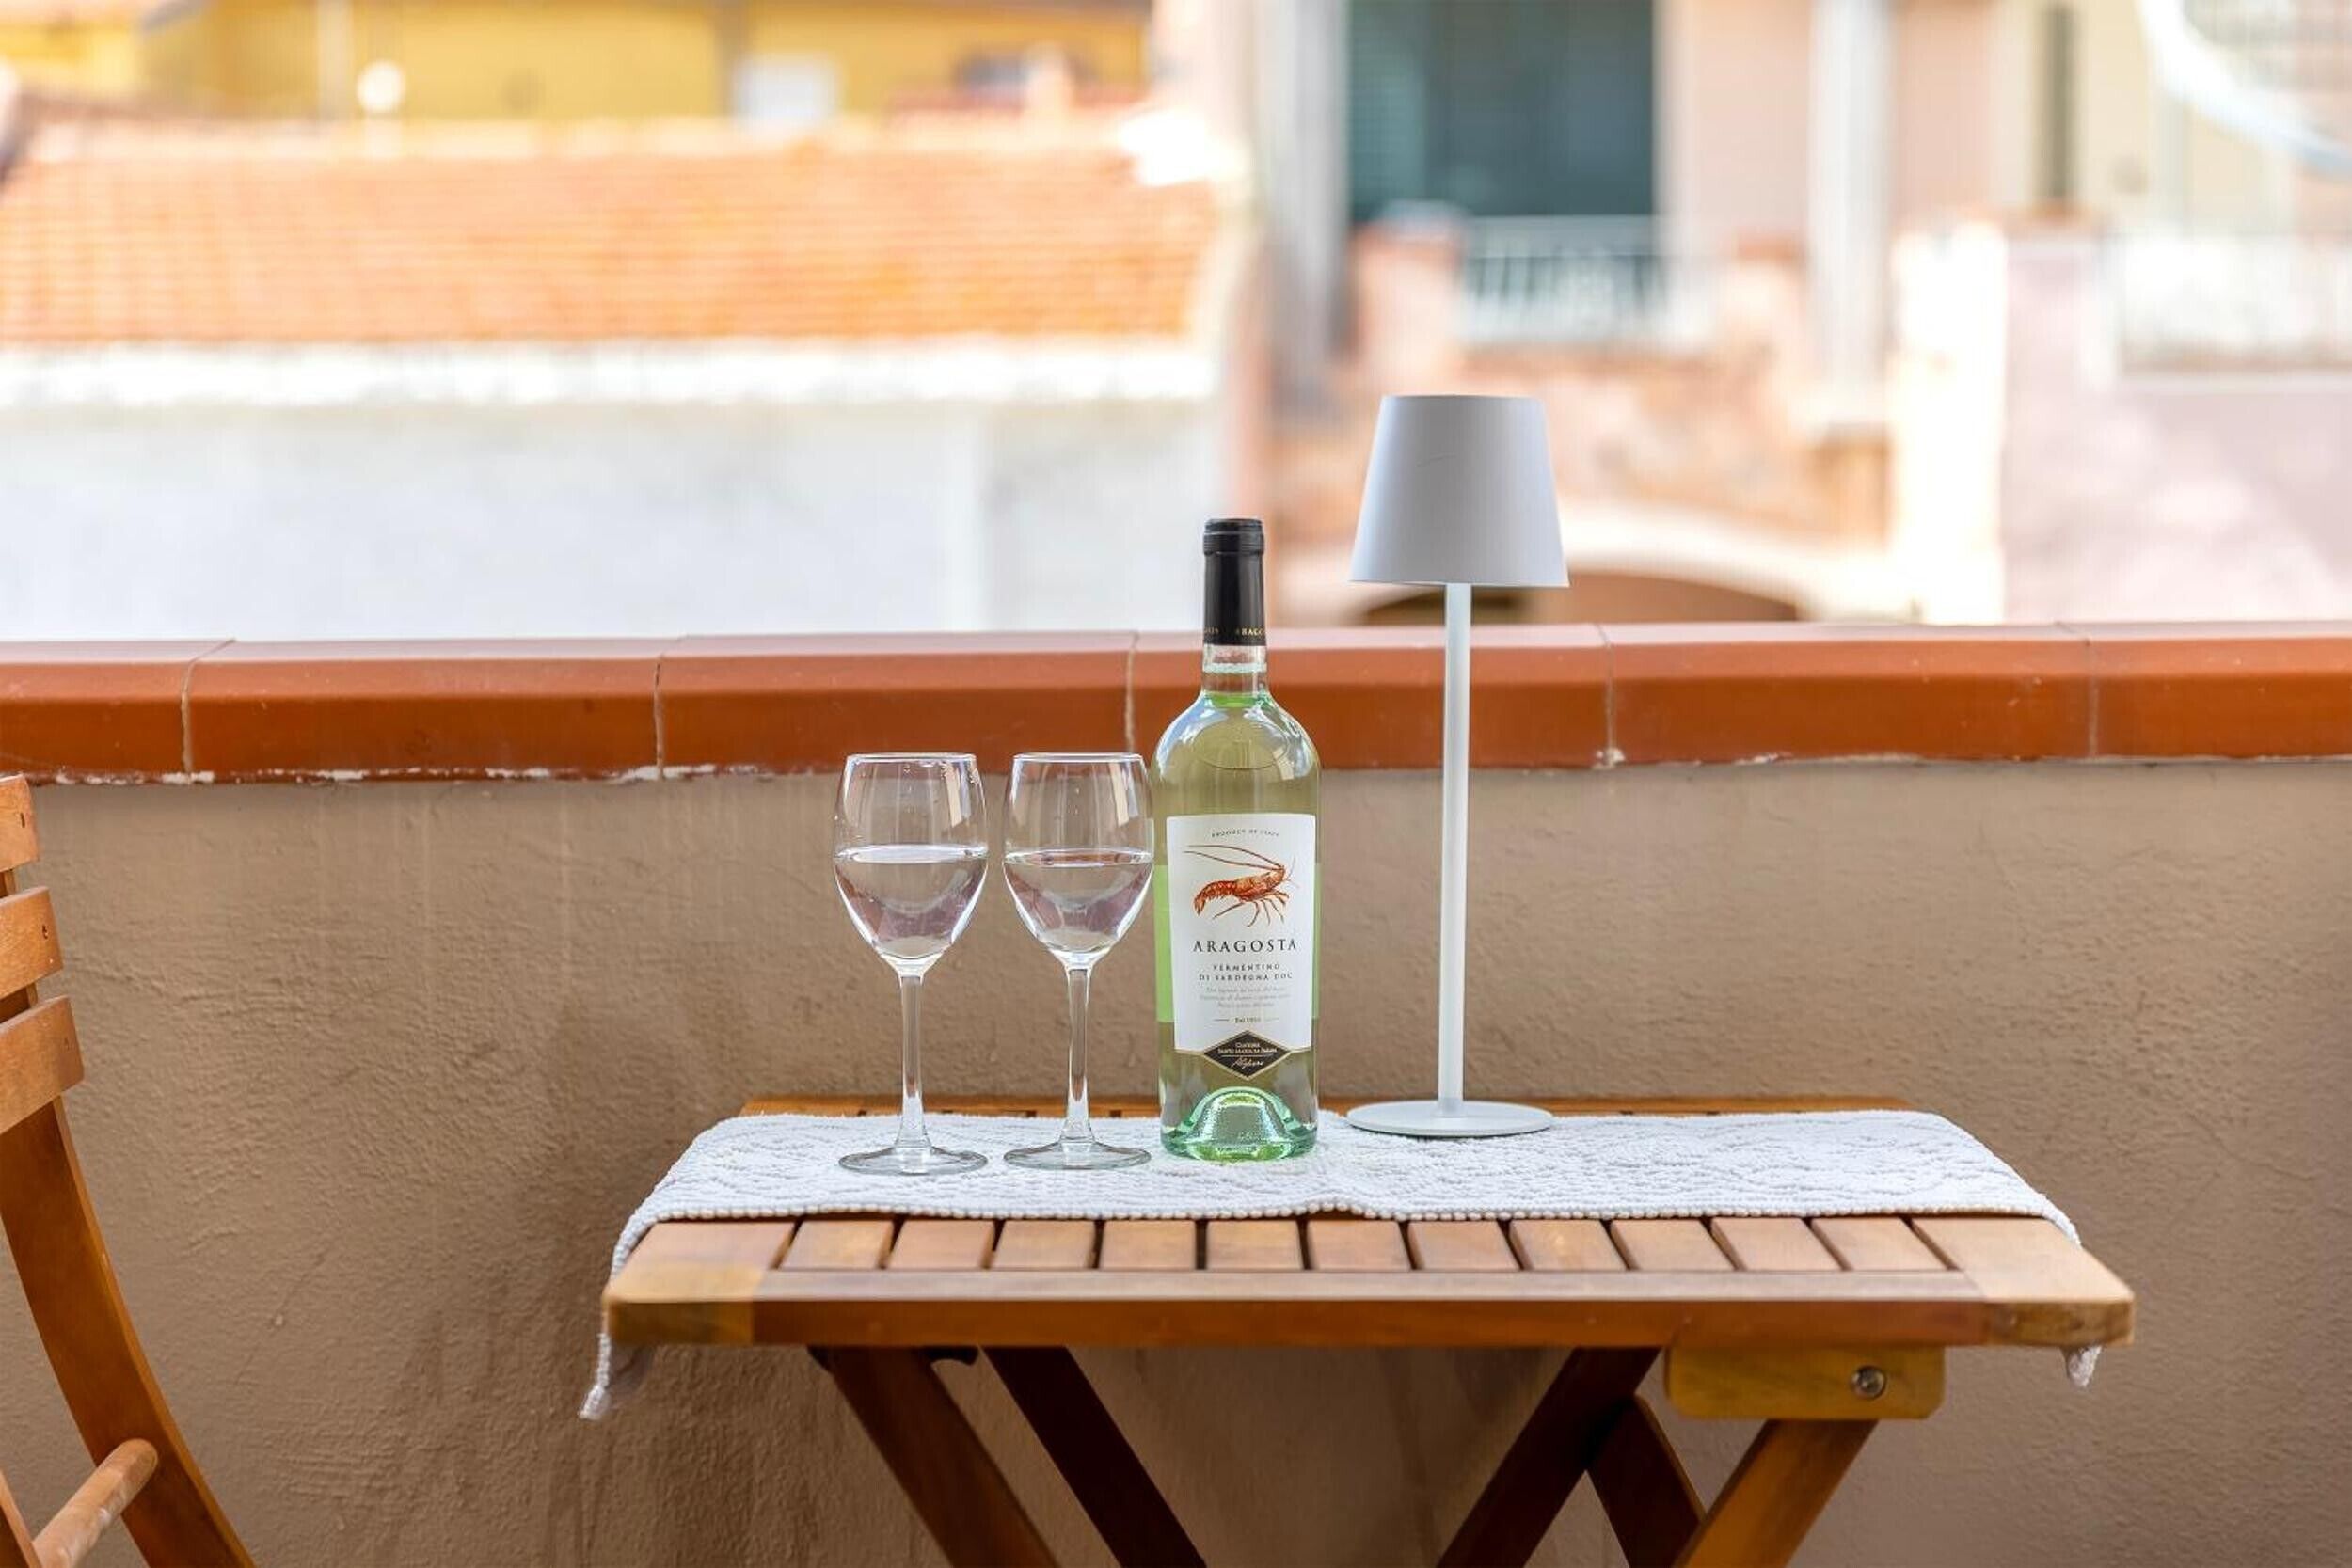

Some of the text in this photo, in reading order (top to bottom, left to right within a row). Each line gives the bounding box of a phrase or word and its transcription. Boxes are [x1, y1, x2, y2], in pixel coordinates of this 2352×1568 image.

[1192, 938, 1297, 953] ARAGOSTA
[1213, 963, 1280, 972] VERMENTINO
[1274, 972, 1294, 980] DOC
